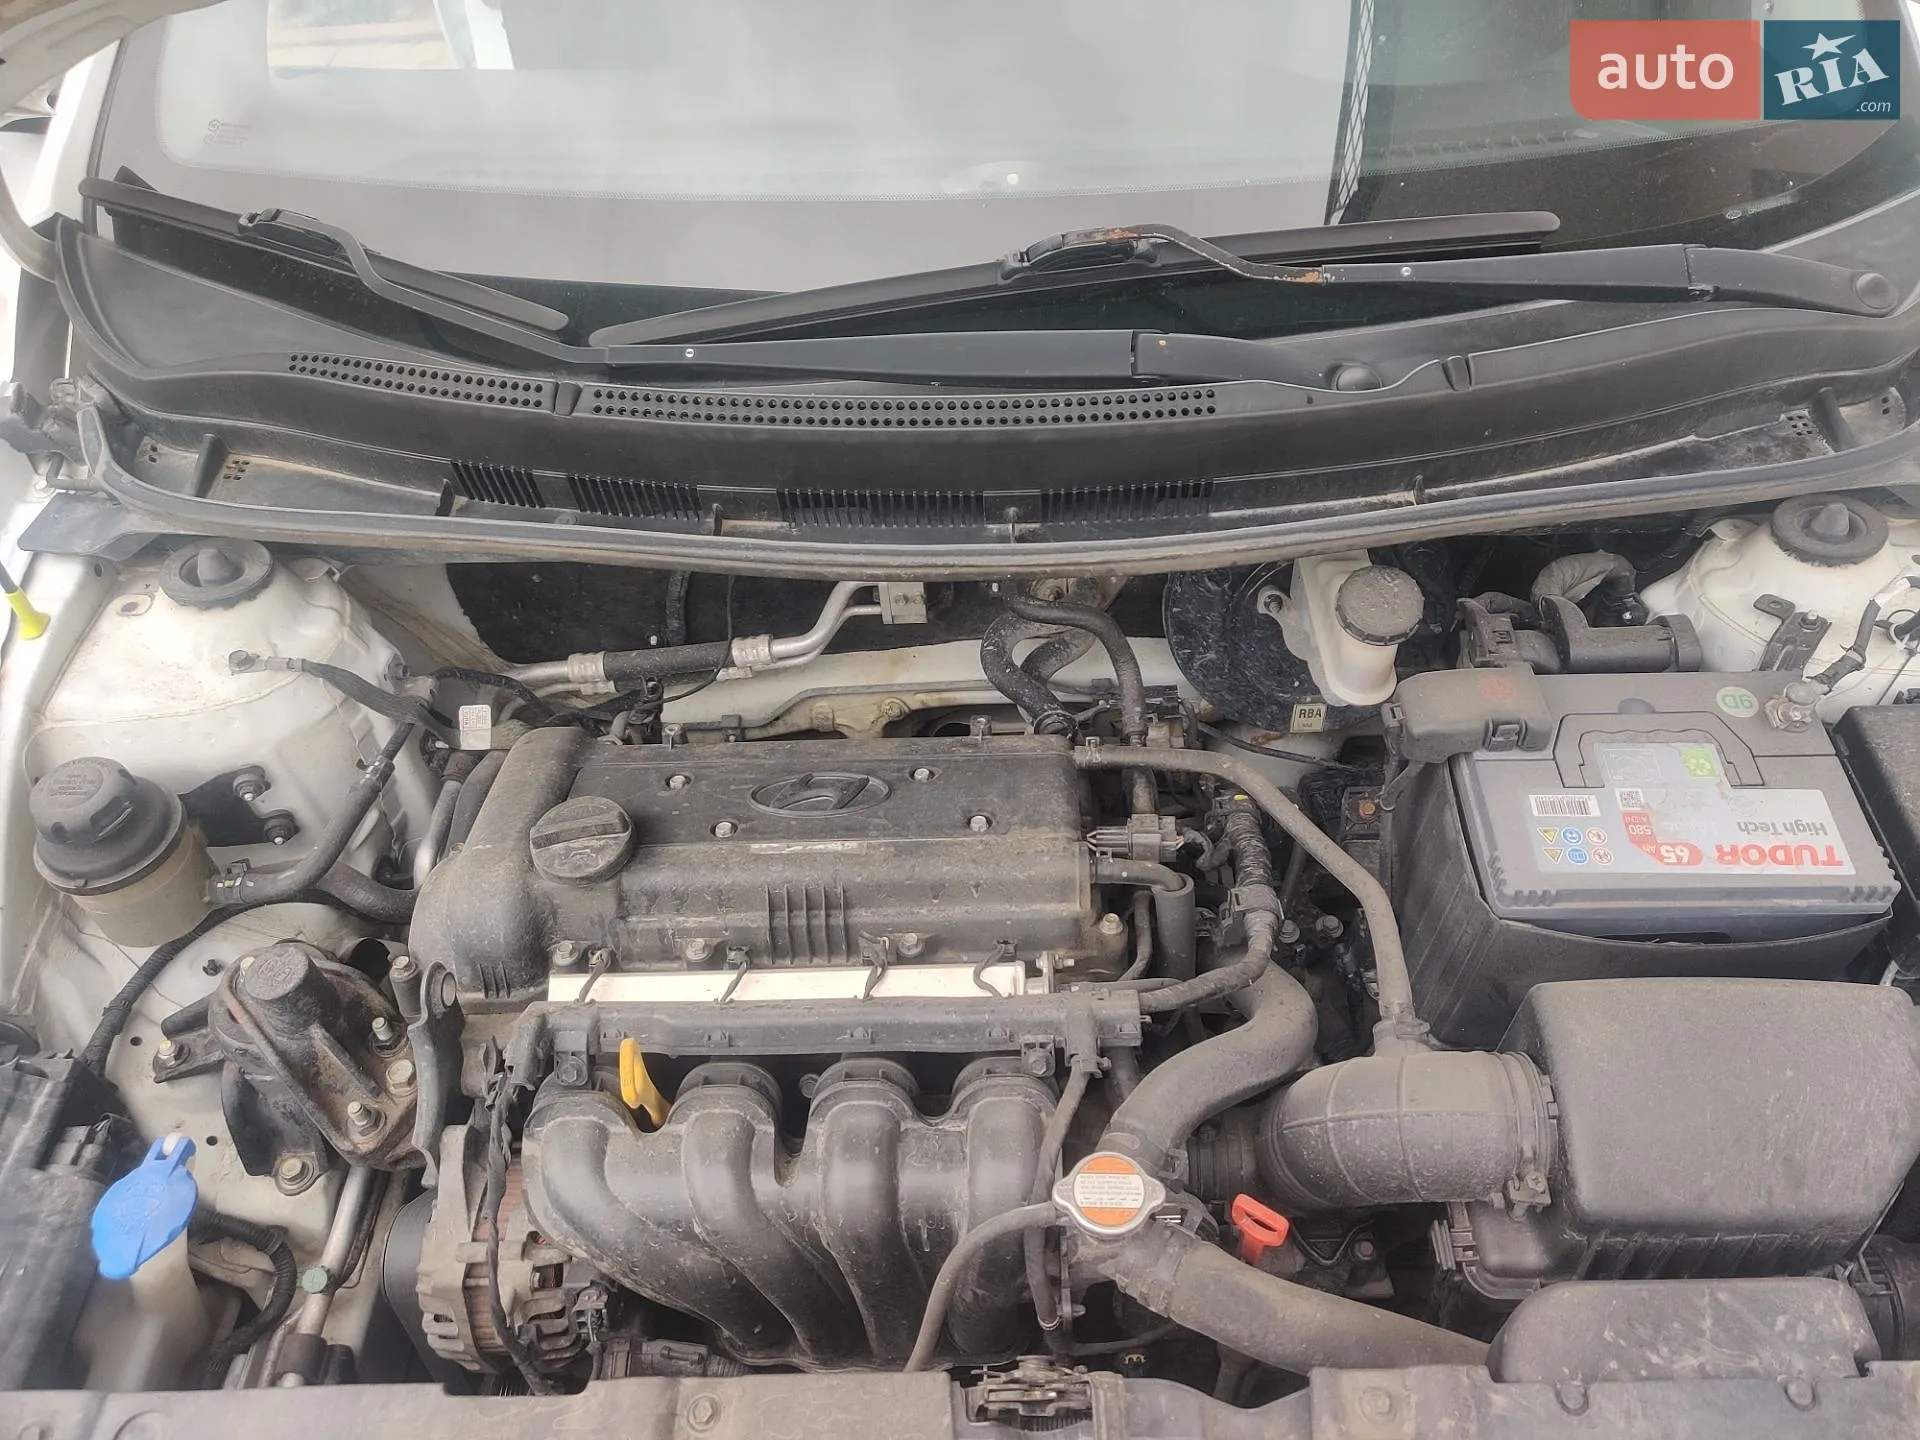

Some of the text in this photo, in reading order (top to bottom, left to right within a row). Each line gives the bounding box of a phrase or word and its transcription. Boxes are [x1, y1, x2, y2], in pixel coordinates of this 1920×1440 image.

[1298, 708, 1322, 719] RBA
[1628, 824, 1652, 835] 580
[1736, 820, 1783, 836] Tech
[1783, 819, 1828, 836] High
[1660, 844, 1690, 863] 65
[1714, 843, 1845, 867] TUDOR
